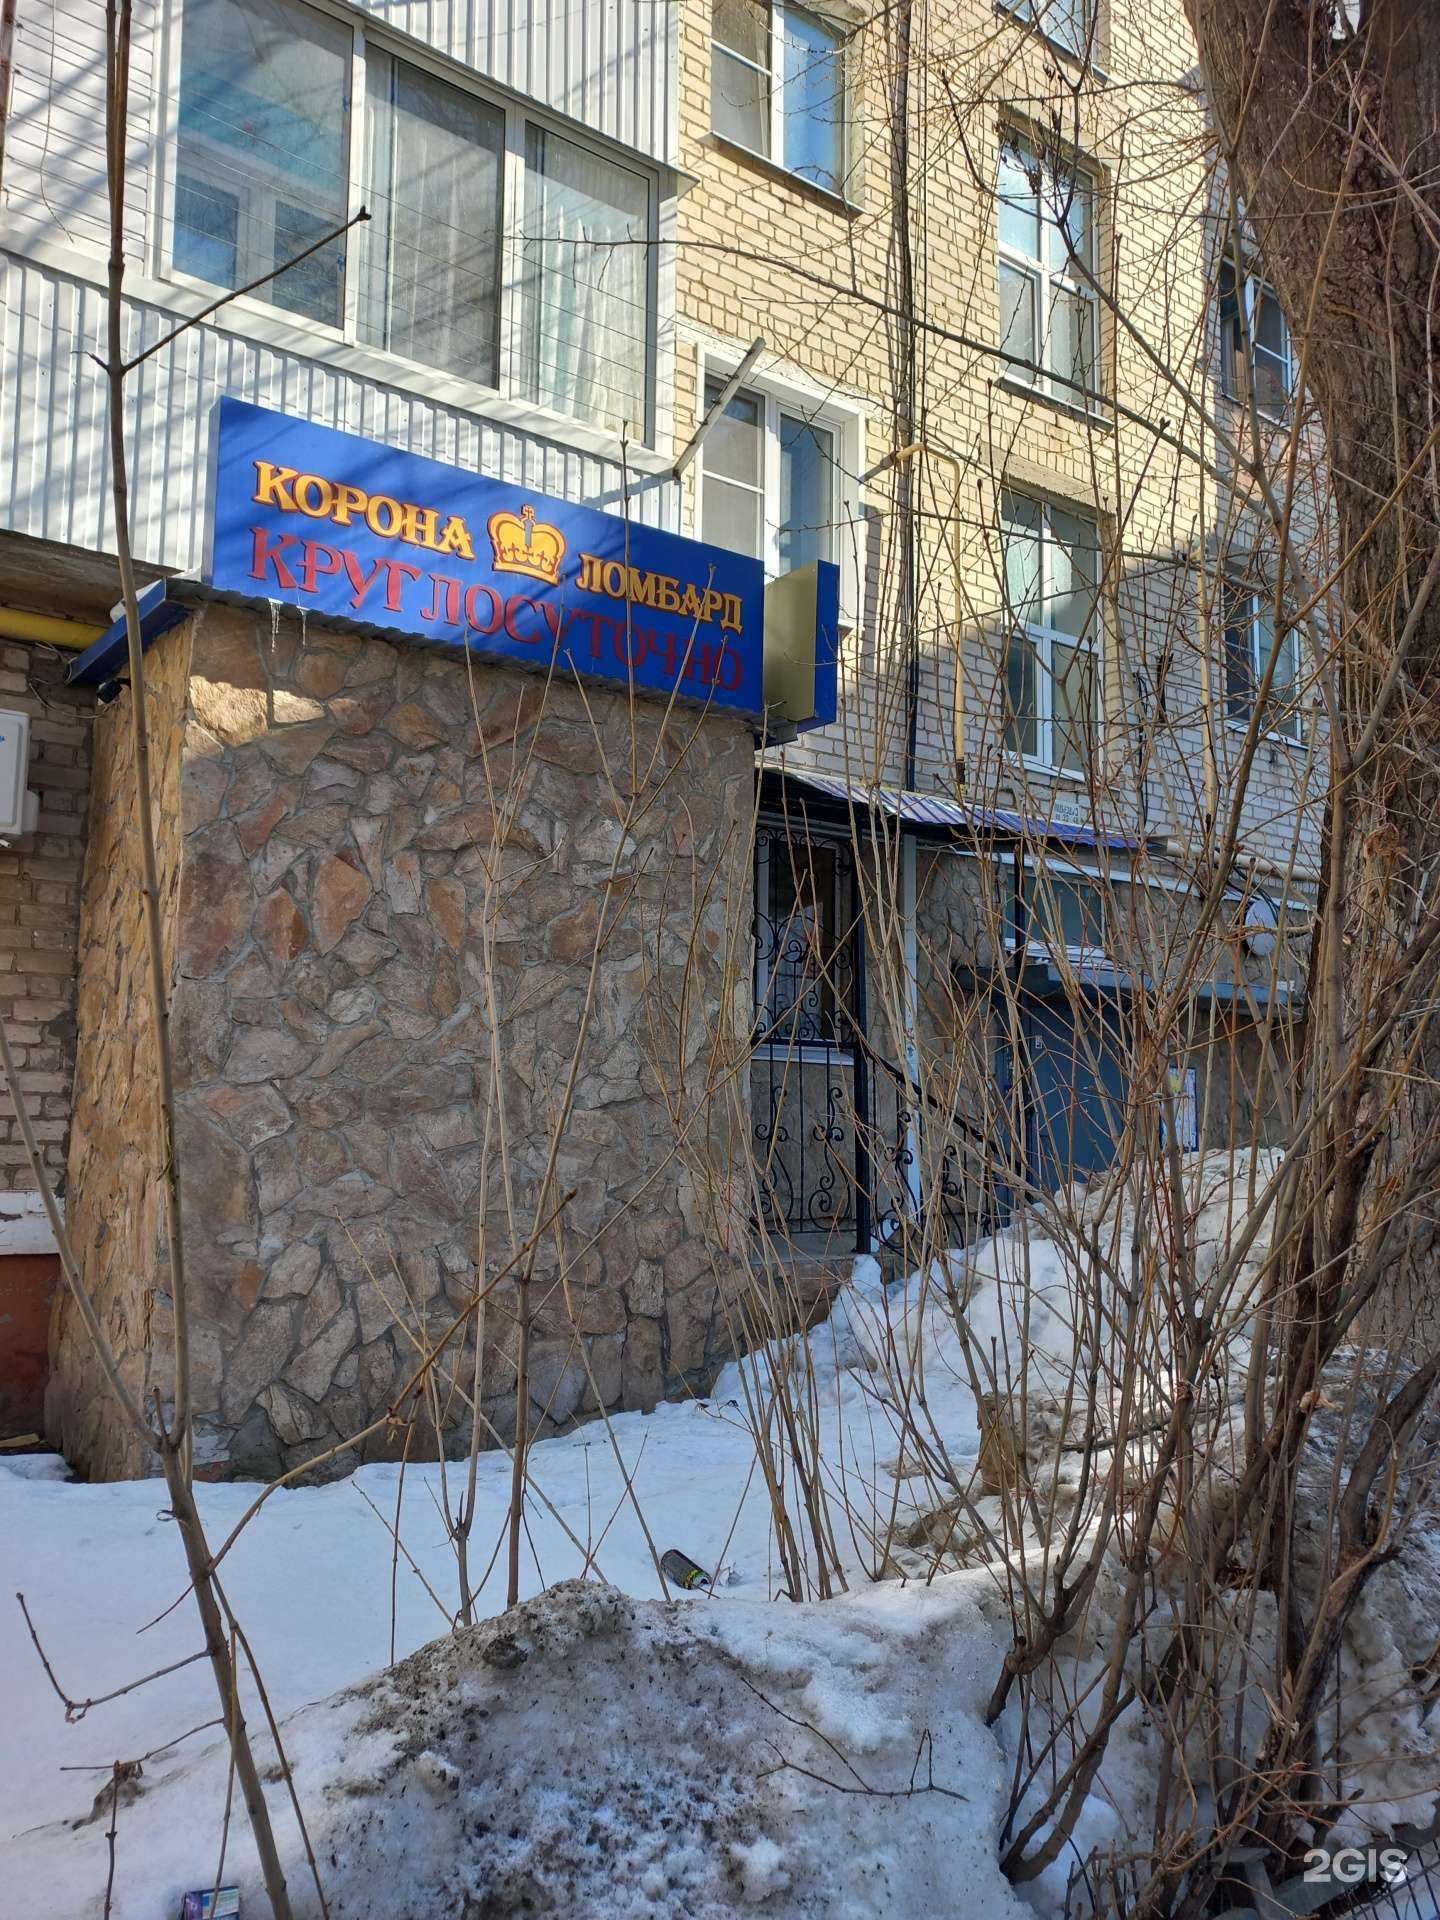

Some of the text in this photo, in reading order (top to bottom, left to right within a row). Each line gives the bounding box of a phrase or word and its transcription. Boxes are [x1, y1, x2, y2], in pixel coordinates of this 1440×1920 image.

[249, 527, 743, 691] КРУГЛОСУТОЧНО
[254, 461, 743, 633] КОРОНА ЛОМБАРД
